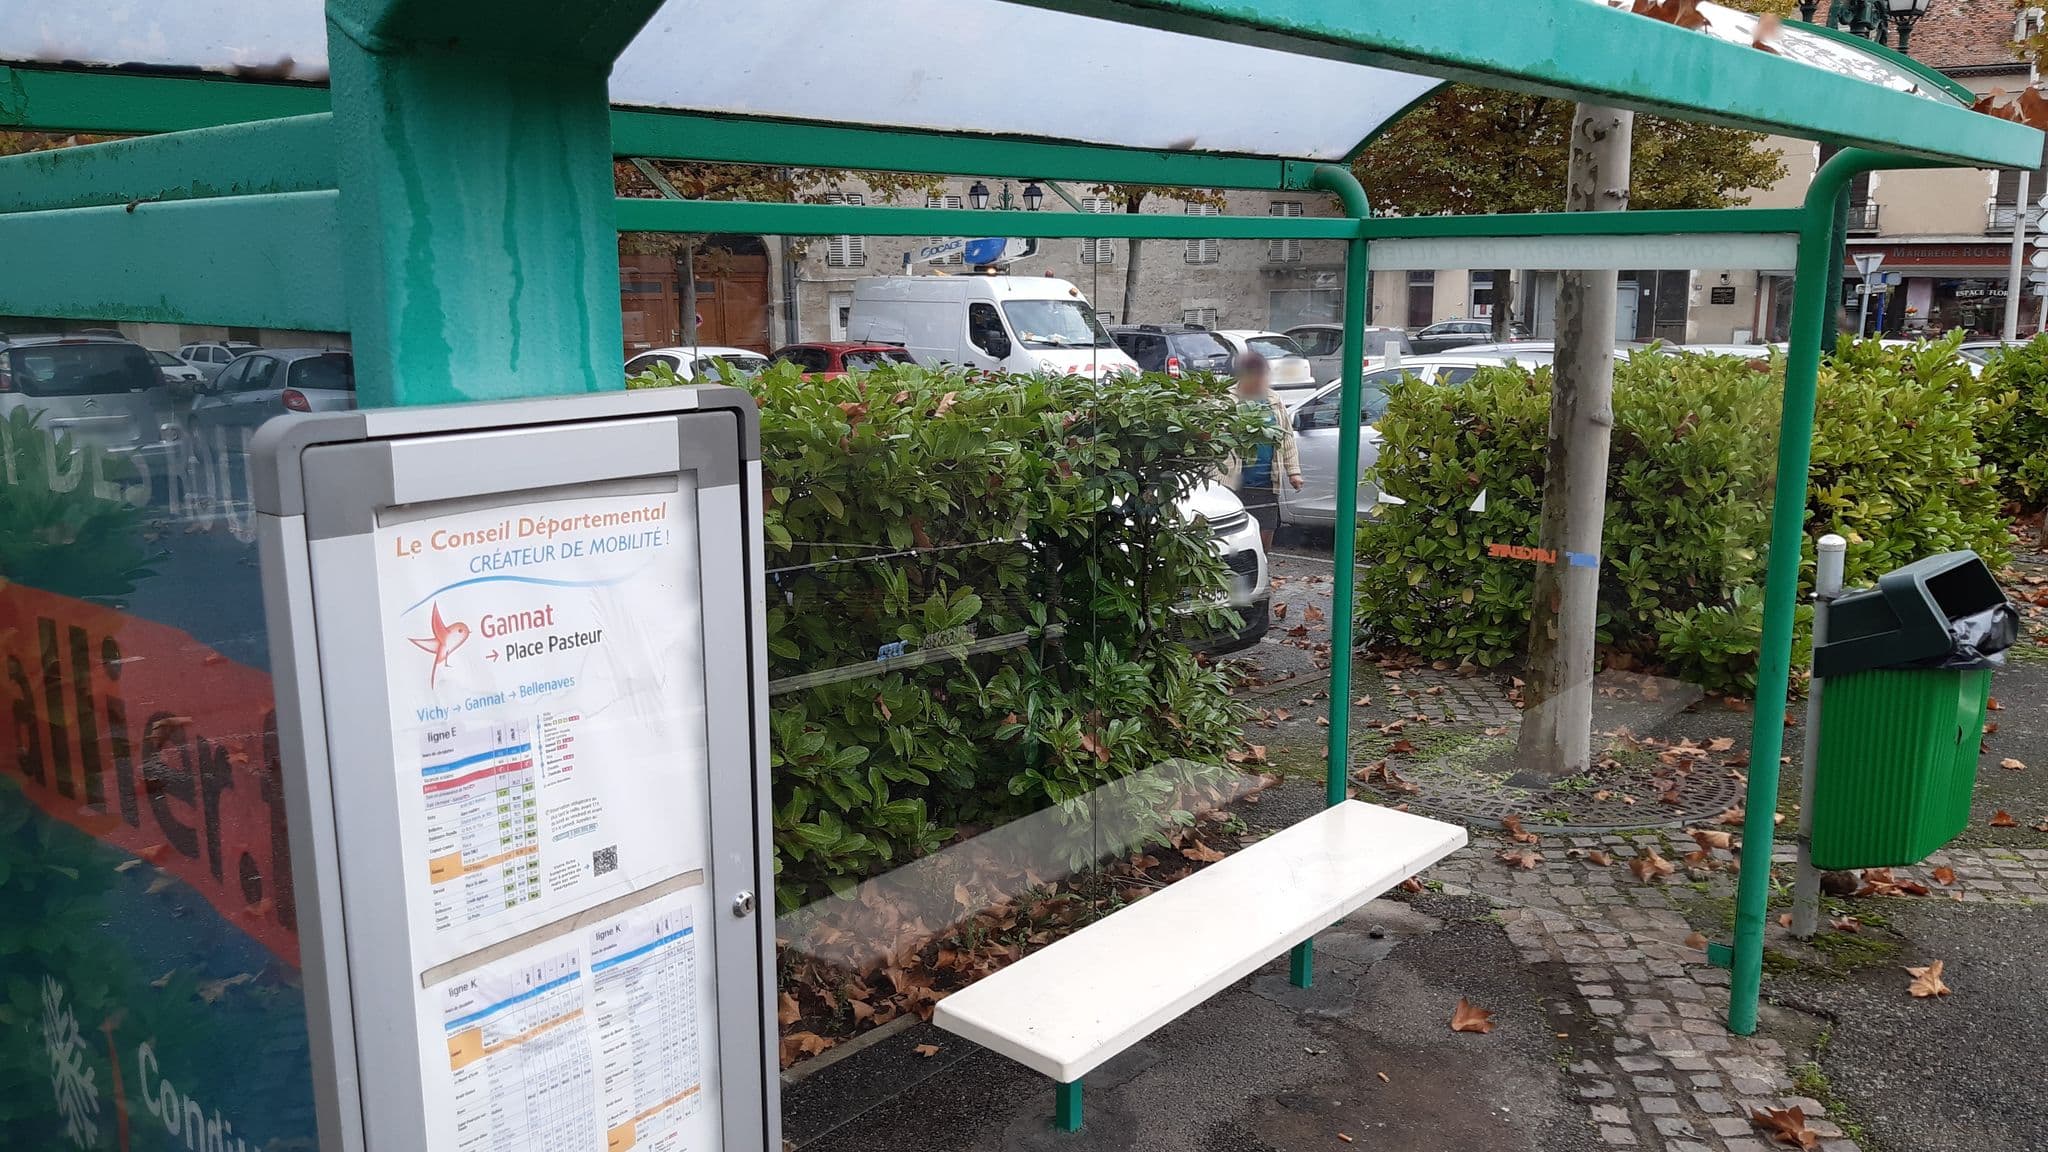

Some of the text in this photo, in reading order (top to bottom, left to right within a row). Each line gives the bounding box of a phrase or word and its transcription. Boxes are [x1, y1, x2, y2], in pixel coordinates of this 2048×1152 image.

[1955, 289, 1985, 297] ESPACE
[396, 502, 667, 557] Le Conseil Départemental
[469, 543, 555, 574] CRÉATEUR
[561, 540, 584, 559] DE
[481, 604, 555, 639] Gannat
[506, 628, 603, 663] Place Pasteur
[417, 675, 576, 725] Vichy Gannat Bellenaves
[427, 726, 457, 744] ligne E
[595, 924, 622, 942] ligne K
[448, 978, 478, 998] ligne K
